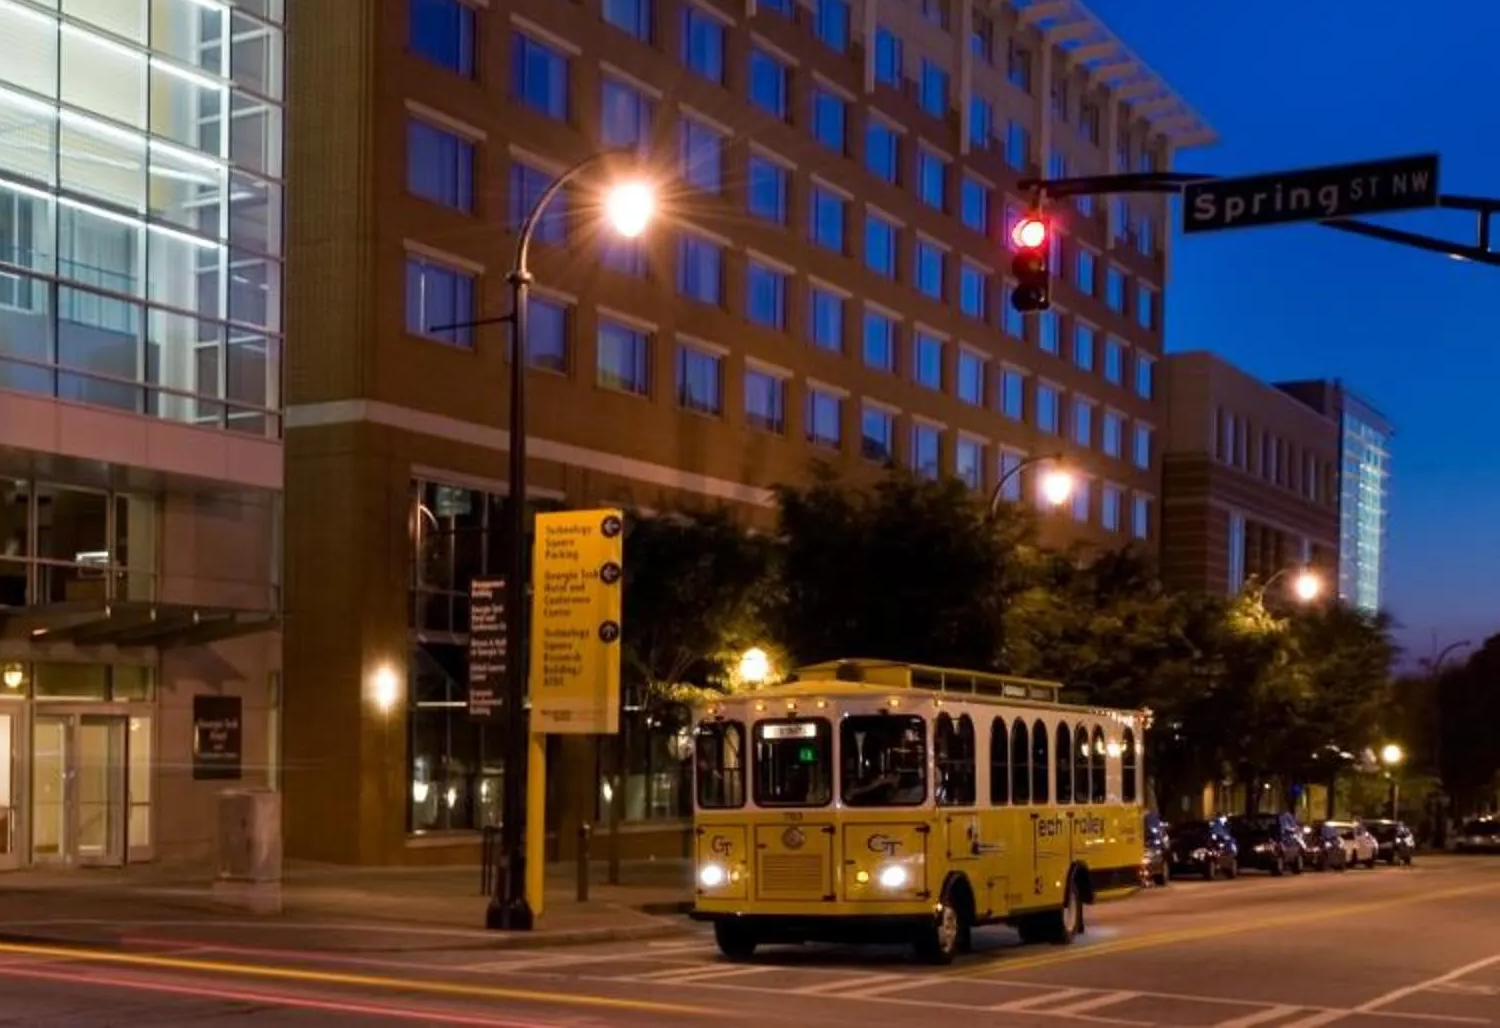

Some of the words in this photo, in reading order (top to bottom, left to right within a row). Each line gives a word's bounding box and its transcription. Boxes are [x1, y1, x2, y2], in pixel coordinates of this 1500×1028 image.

[1194, 183, 1339, 222] Spring
[1350, 176, 1380, 200] ST
[1392, 171, 1429, 195] NW
[711, 835, 733, 857] GT
[867, 833, 902, 856] GT
